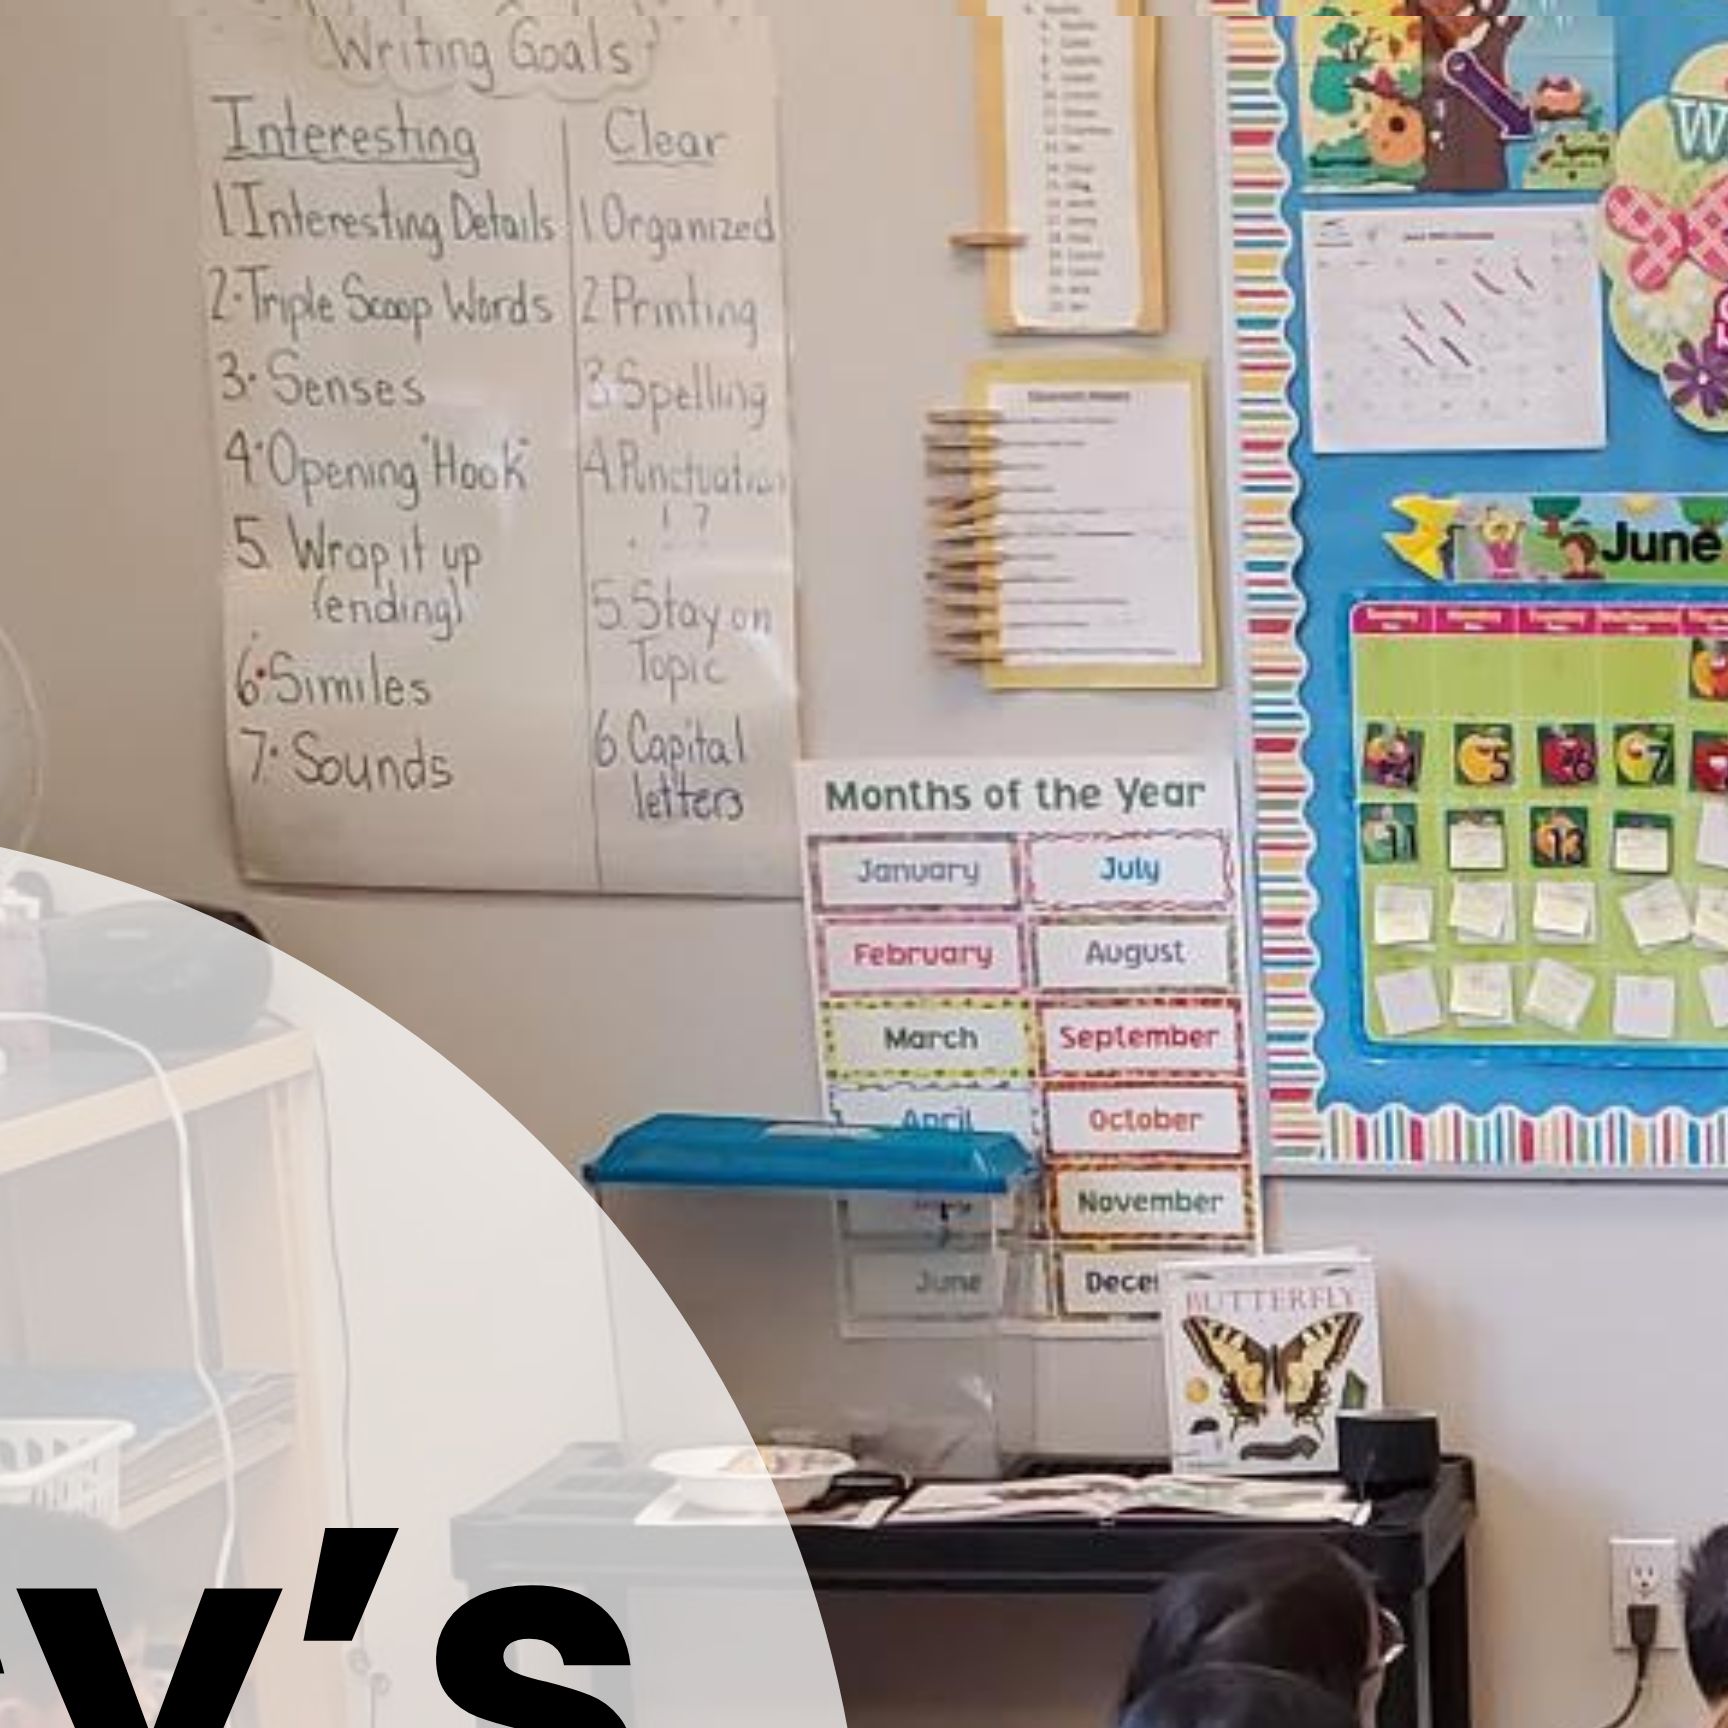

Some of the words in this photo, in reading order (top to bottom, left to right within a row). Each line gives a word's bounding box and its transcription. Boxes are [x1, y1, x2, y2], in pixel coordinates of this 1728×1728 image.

[327, 12, 494, 92] Writing
[509, 17, 632, 74] Goals
[211, 96, 481, 177] Interesting
[605, 108, 729, 161] Clear
[239, 182, 445, 258] Interesting
[450, 190, 555, 242] Details
[602, 193, 774, 259] Organized
[242, 265, 334, 340] Triple
[342, 272, 432, 341] Scoop
[443, 281, 555, 324] Words
[611, 275, 758, 347] Printing
[271, 348, 426, 406] Senses
[623, 362, 768, 433] Spelling
[270, 430, 420, 511] Opening
[288, 517, 390, 588] Wrap
[398, 520, 427, 565] it
[443, 540, 483, 588] up
[1602, 524, 1722, 566] June
[314, 577, 463, 641] (ending)
[633, 578, 719, 637] Stay
[731, 605, 771, 632] on
[271, 650, 431, 705] Similes
[632, 637, 726, 700] Topic
[293, 729, 455, 790] Sounds
[627, 710, 748, 775] Capital
[1489, 745, 1510, 781] 5
[1651, 745, 1671, 781] 7
[633, 769, 743, 822] letters
[825, 779, 970, 812] Months
[985, 778, 1017, 810] of
[1038, 778, 1102, 810] the
[1114, 777, 1206, 815] Year
[1099, 855, 1161, 886] July
[1551, 826, 1586, 862] 13
[857, 857, 981, 887] January
[853, 940, 994, 971] February
[1085, 938, 1188, 969] August
[884, 1025, 978, 1051] March
[1060, 1025, 1220, 1054] September
[1089, 1108, 1204, 1133] October
[1079, 1189, 1224, 1216] November
[915, 1269, 981, 1296] June
[1186, 1286, 1354, 1312] BUTTERFLY
